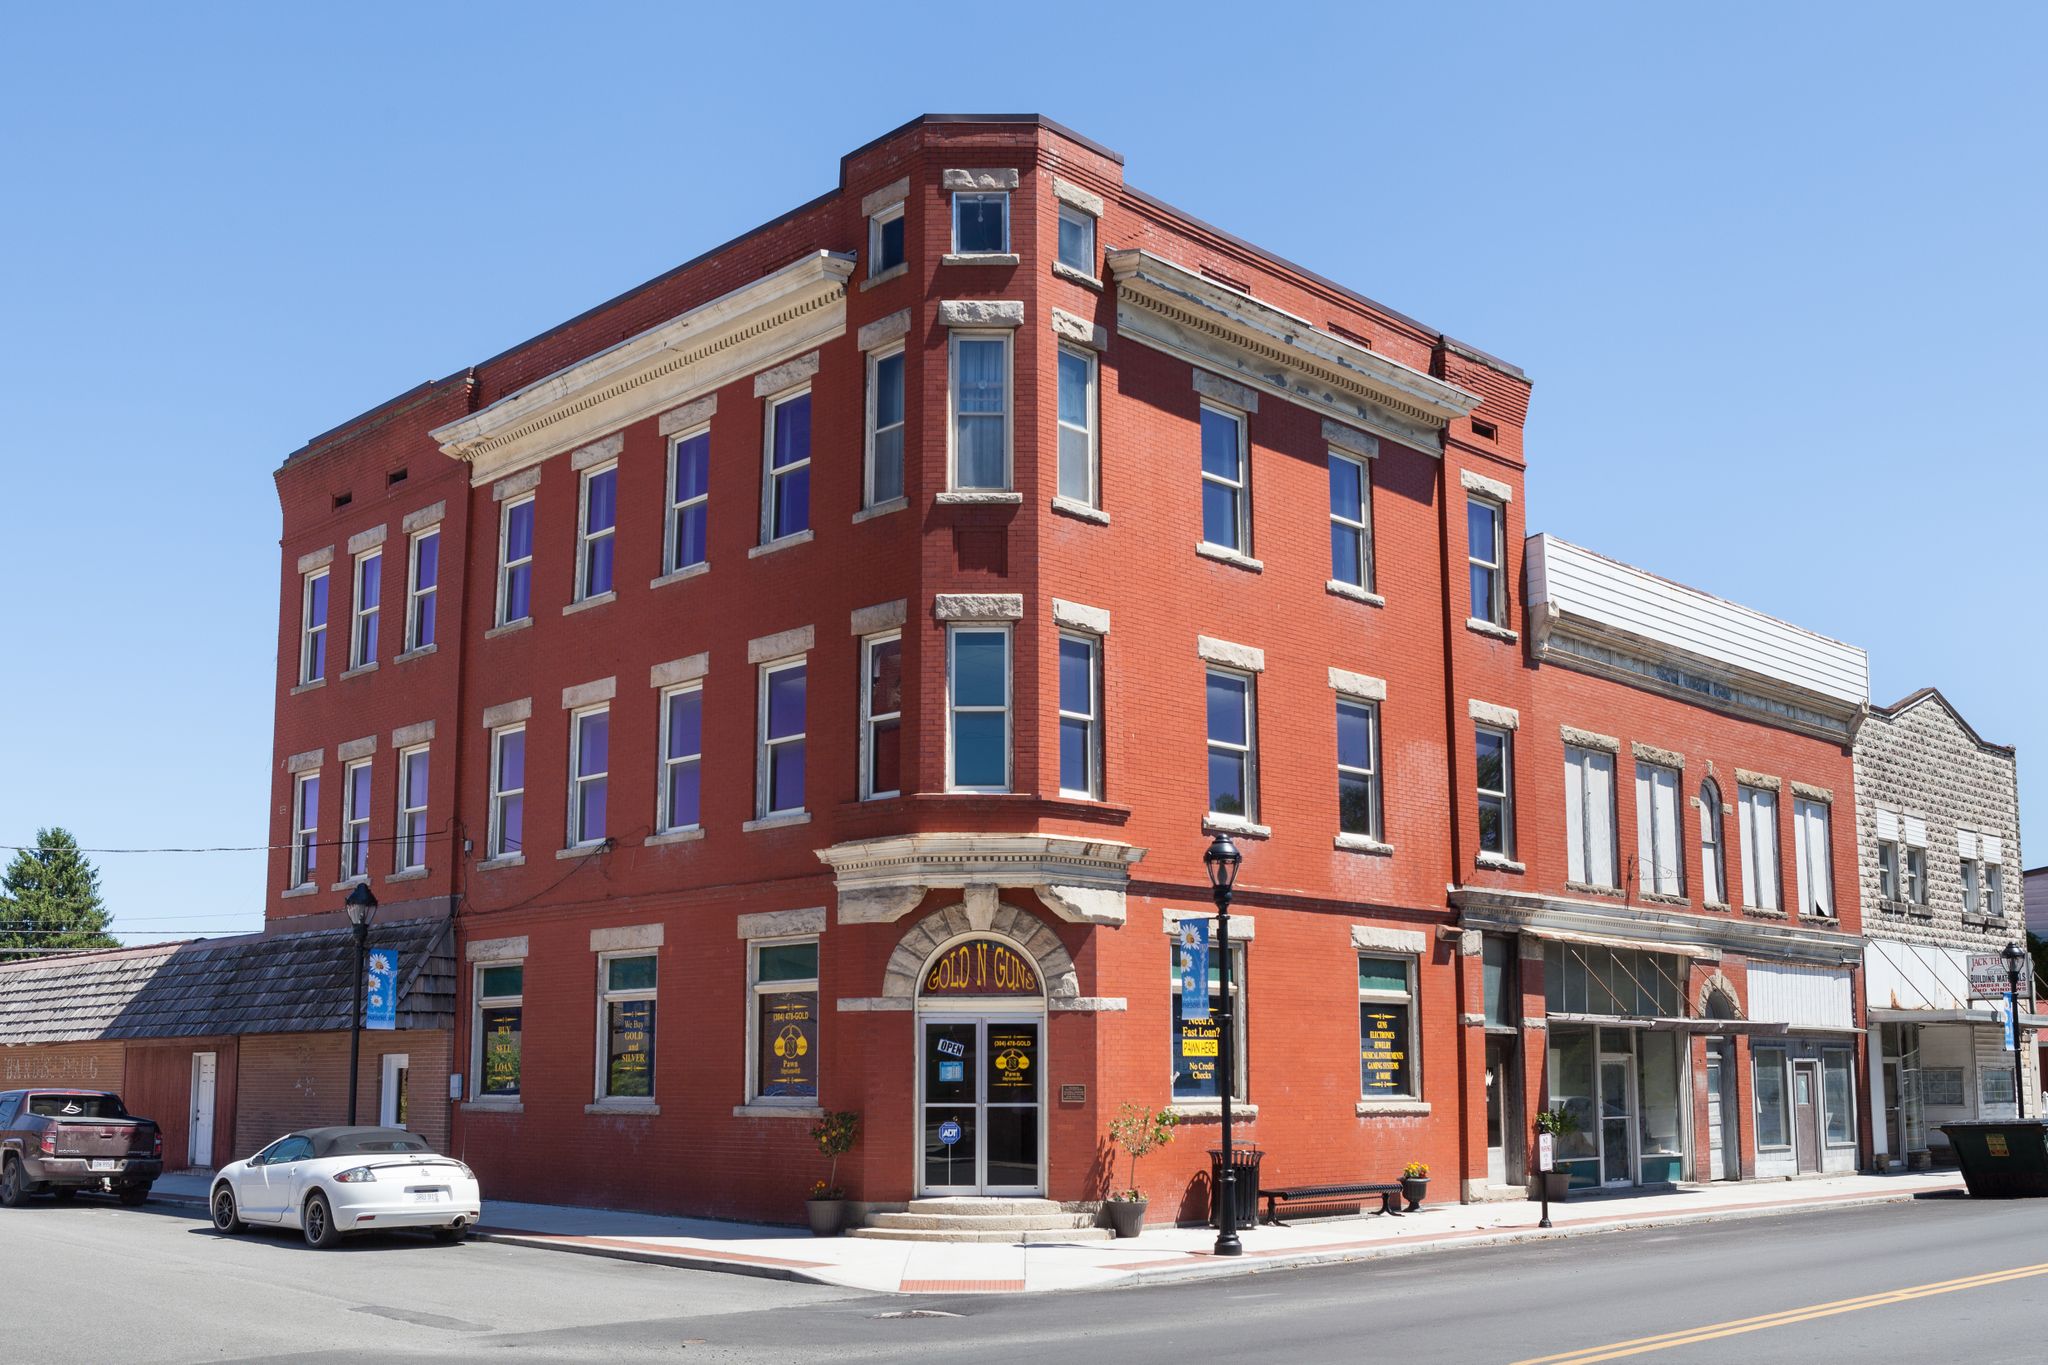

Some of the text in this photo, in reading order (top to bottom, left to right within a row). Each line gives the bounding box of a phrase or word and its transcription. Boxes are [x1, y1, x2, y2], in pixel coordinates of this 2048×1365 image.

[928, 944, 1035, 990] GOLD N GUNS
[1971, 957, 1988, 969] JACK
[1970, 974, 1995, 983] BUILDING
[624, 1020, 644, 1030] We Buy
[1376, 1021, 1388, 1029] GUNS
[498, 1026, 511, 1036] BUY
[624, 1031, 644, 1040] GOLD
[1182, 1026, 1220, 1037] Fast Loan?
[1369, 1031, 1396, 1039] ELECTRONICS
[495, 1043, 511, 1053] SELL
[628, 1042, 639, 1051] and
[940, 1040, 963, 1056] OPEN
[1184, 1041, 1200, 1054] PAWN
[1374, 1041, 1391, 1049] JEWELRY
[622, 1053, 646, 1062] SILVER
[1362, 1051, 1404, 1060] MUSICAL INSTRUMENTS
[495, 1062, 513, 1072] LOAN
[1189, 1062, 1215, 1071] No Credit
[1192, 1071, 1212, 1080] Checks
[1380, 1072, 1391, 1080] MORE
[943, 1128, 958, 1137] ADT
